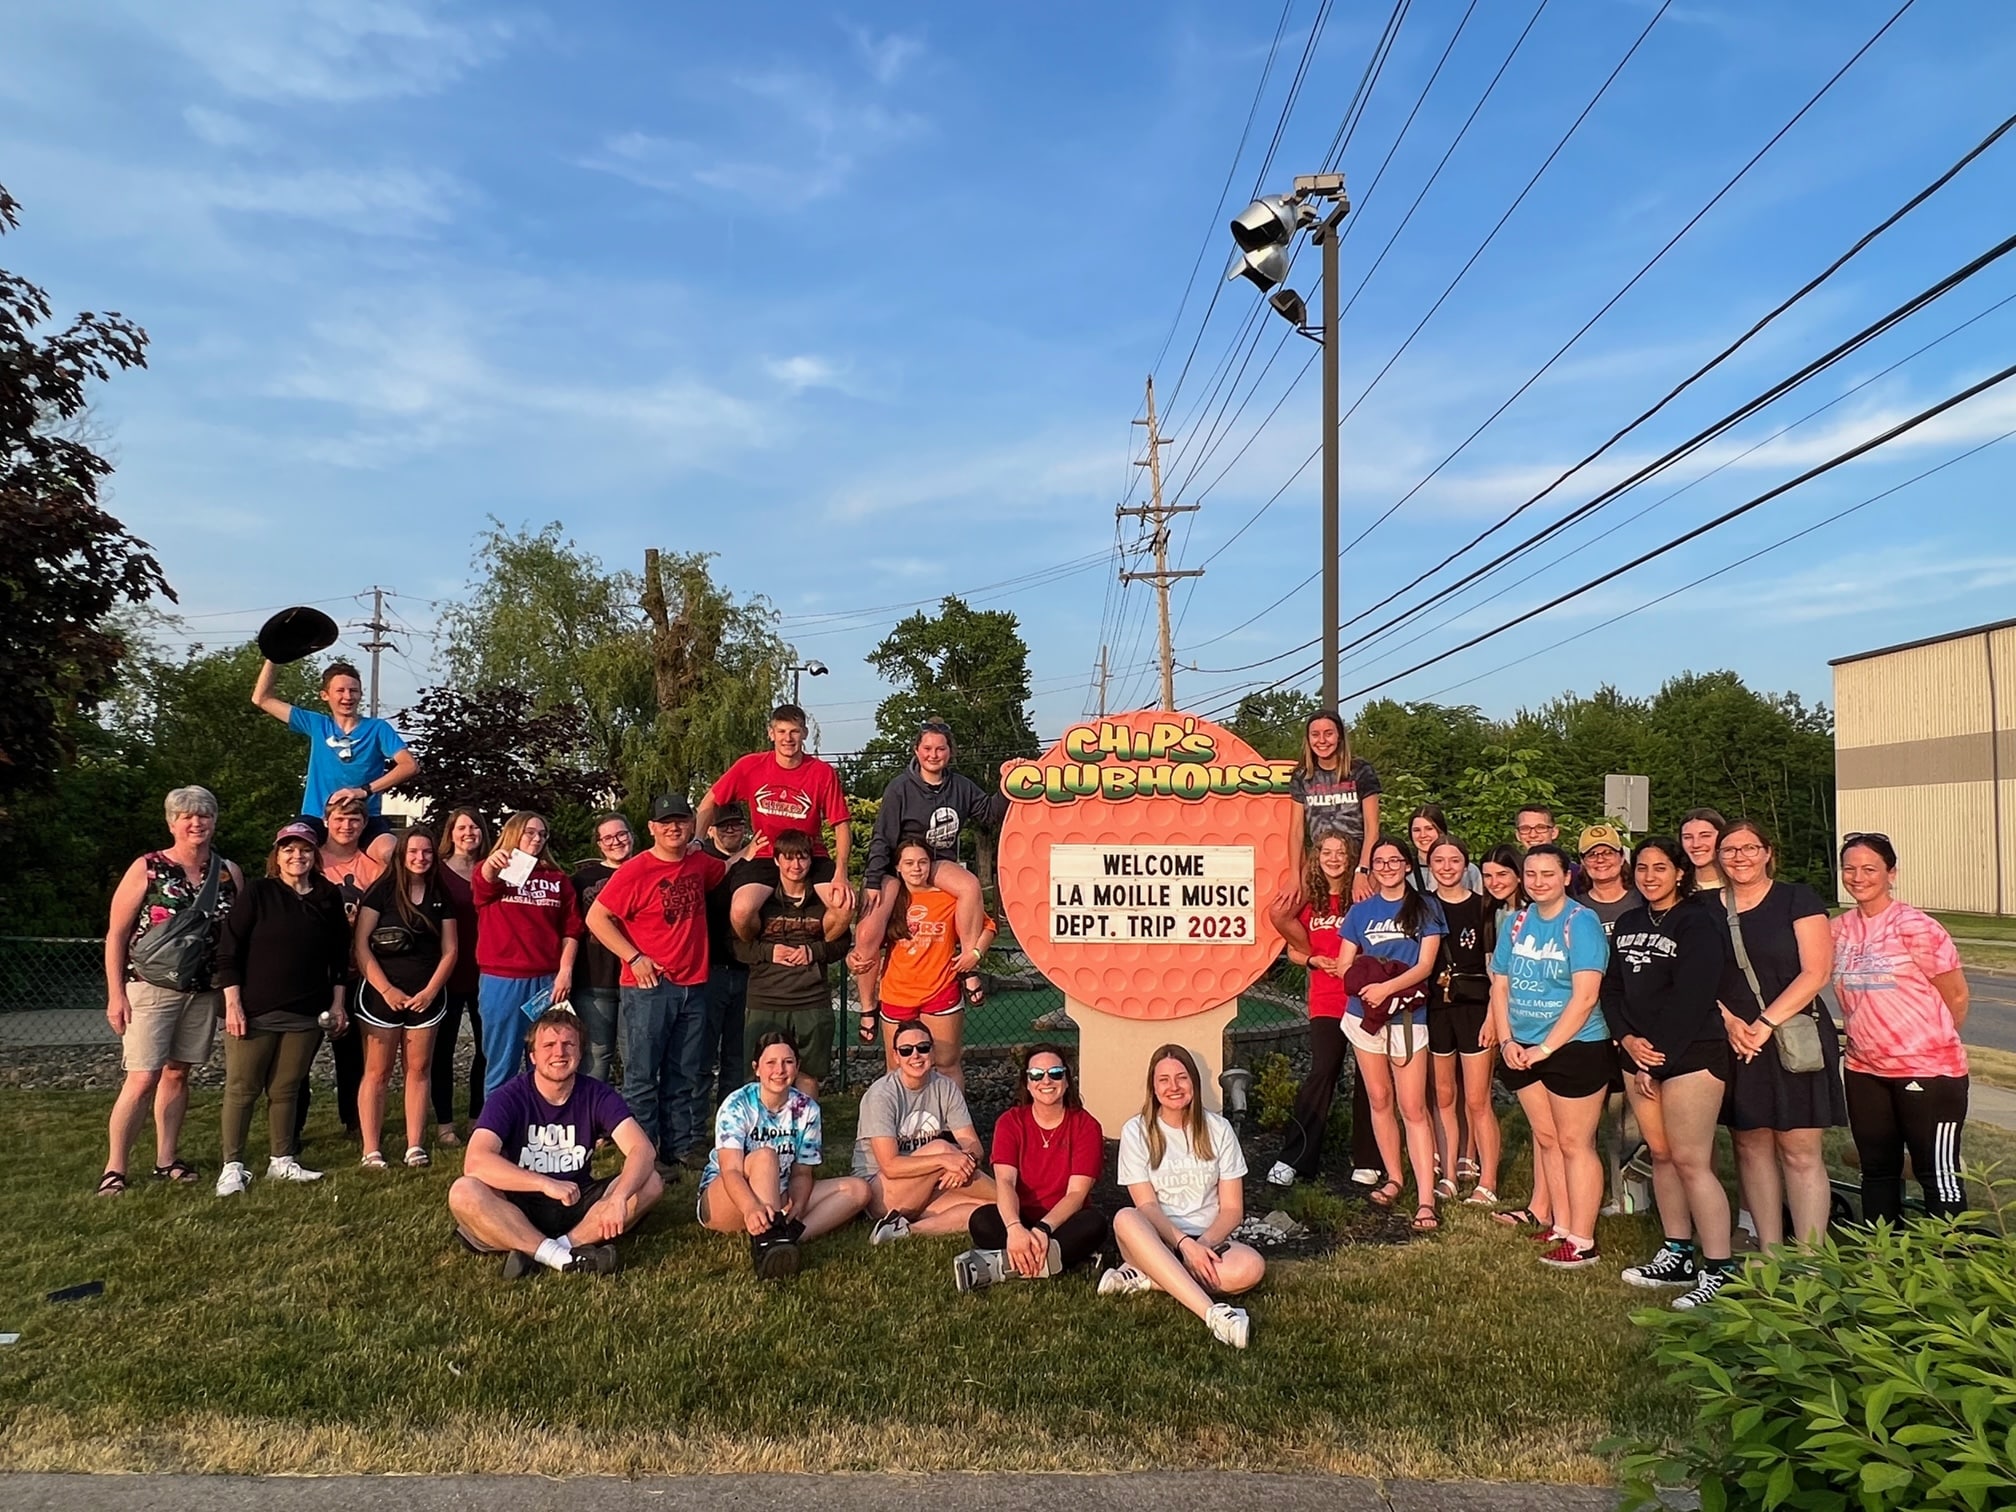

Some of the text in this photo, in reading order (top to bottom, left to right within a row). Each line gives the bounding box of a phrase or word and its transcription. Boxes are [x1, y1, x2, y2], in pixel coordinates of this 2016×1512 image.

[1066, 717, 1215, 761] CHIP'S
[1005, 763, 1295, 800] CLUBHOUSE
[1103, 854, 1204, 876] WELCOME
[1056, 884, 1250, 907] LA MOILLE MUSIC
[1056, 915, 1247, 938] DEPT. TRIP 2023
